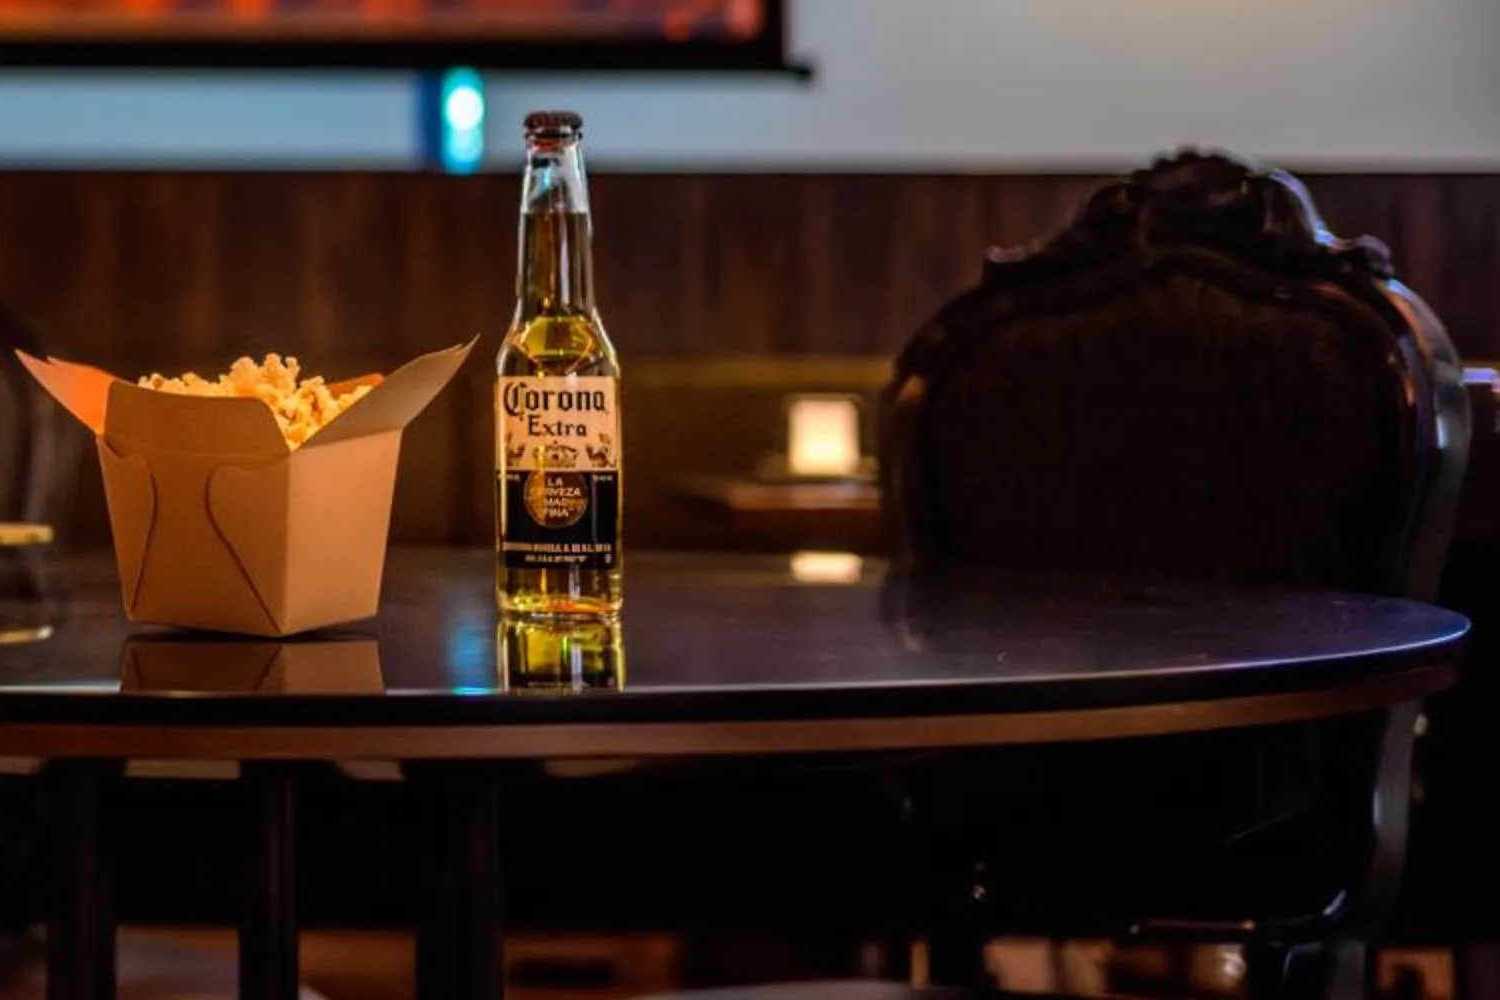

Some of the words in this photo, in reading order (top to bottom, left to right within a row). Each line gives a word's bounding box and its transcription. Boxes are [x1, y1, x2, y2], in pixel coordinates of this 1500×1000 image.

[503, 381, 609, 421] Corona
[528, 414, 587, 437] Extra
[547, 477, 563, 487] LA
